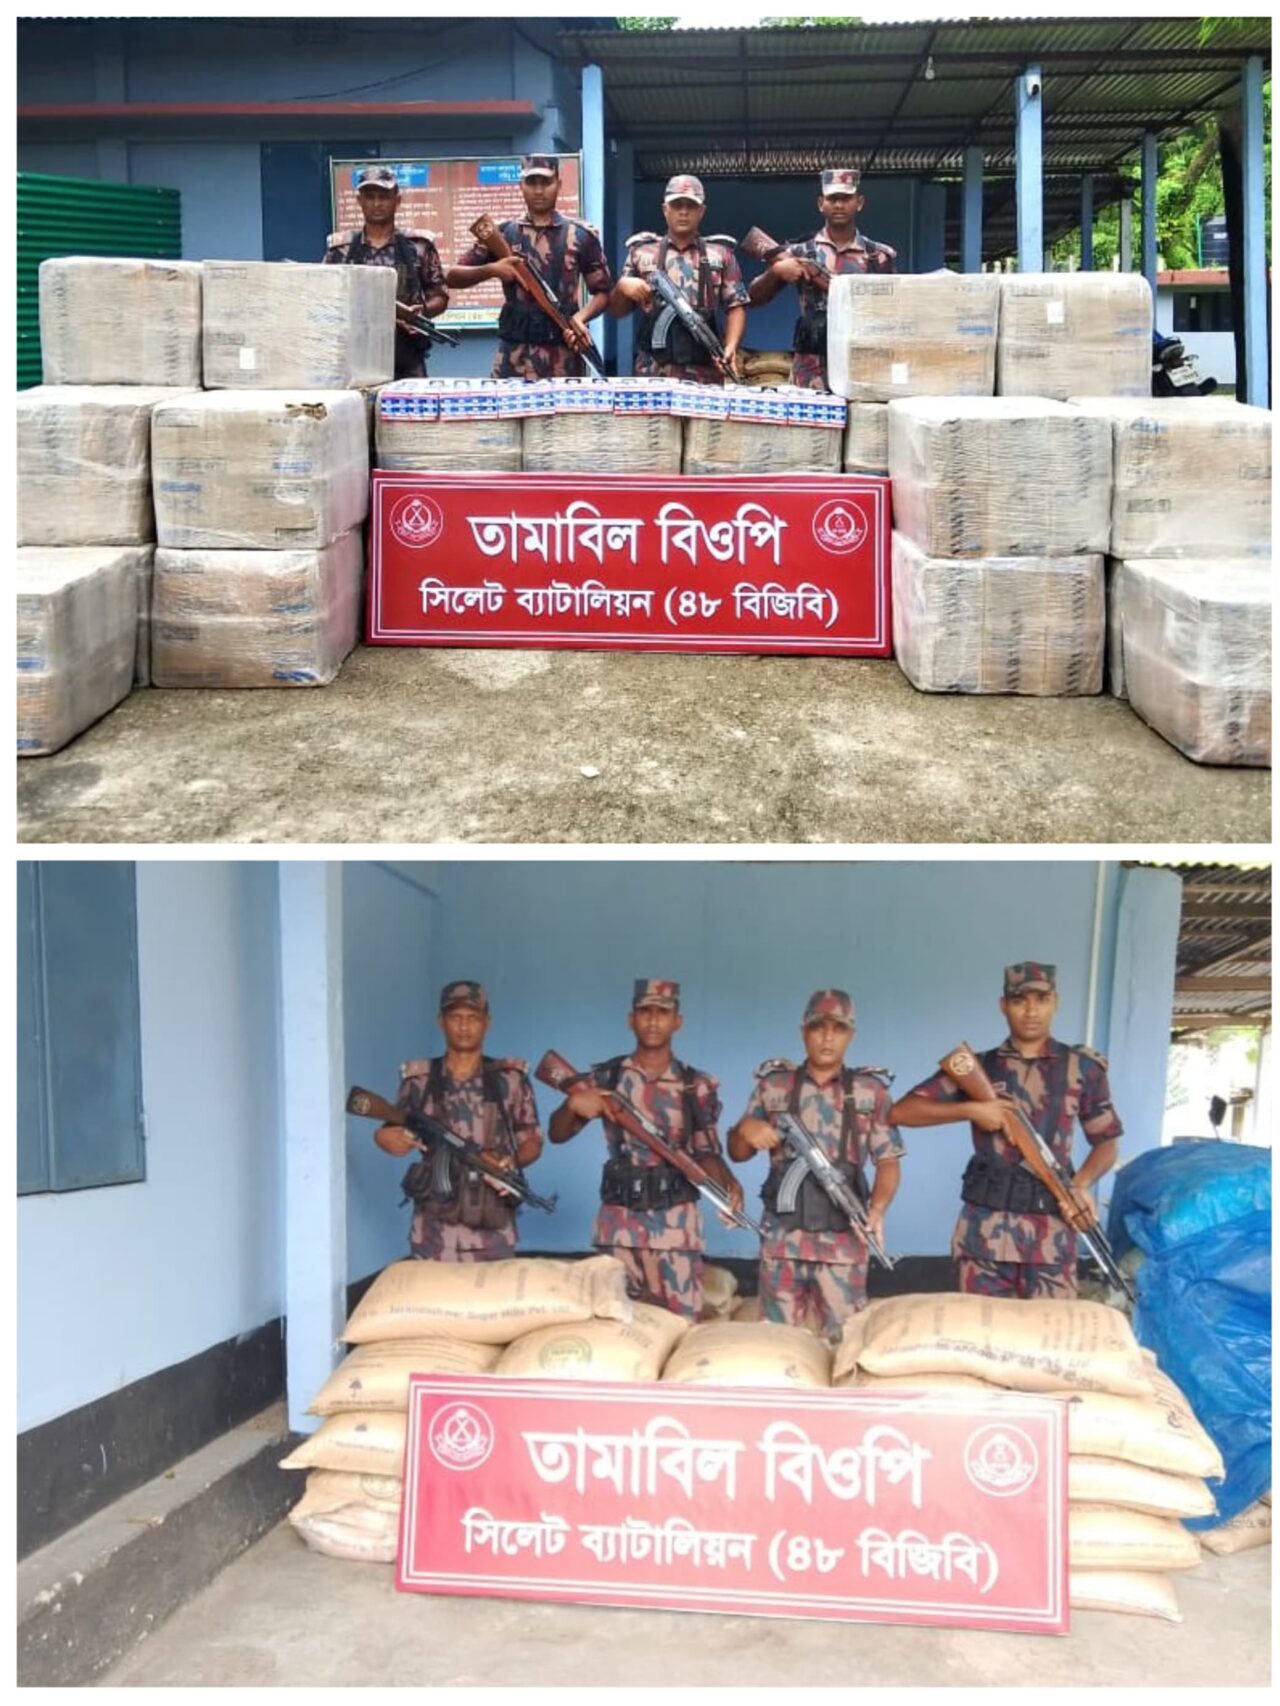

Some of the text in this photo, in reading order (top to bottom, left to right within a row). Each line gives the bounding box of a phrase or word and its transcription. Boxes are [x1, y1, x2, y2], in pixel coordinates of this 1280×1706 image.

[466, 500, 788, 565] তামাবিল বিওপি
[418, 577, 840, 628] সিলেট ব্যাটালিয়ন (৪৮ বিজিবি)
[521, 1414, 936, 1508] তামাবিল বিওপি
[460, 1507, 1000, 1593] সিলেট ব্যাটালিয়ন (৪৮ বিজিবি)
